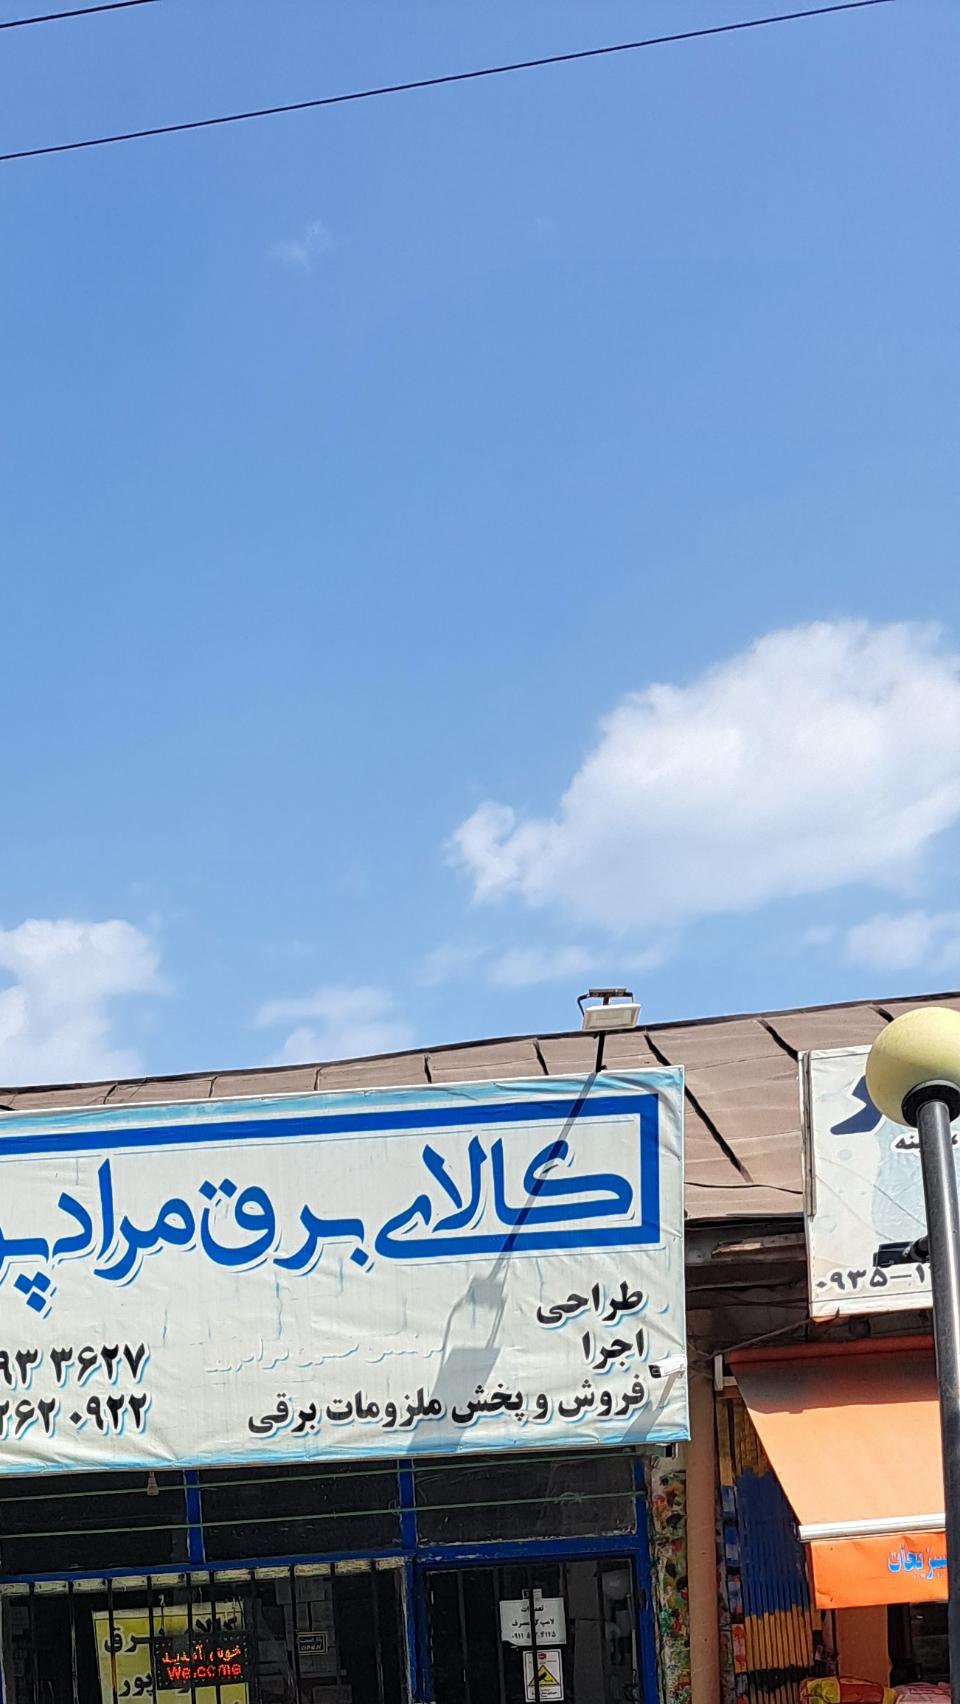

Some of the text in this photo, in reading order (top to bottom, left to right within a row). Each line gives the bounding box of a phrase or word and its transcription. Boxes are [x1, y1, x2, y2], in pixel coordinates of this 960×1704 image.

[375, 1135, 635, 1260] کالای
[200, 1177, 375, 1273] برق
[538, 1281, 643, 1325] طراحی
[49, 1342, 146, 1383] ۳۶۲۷
[583, 1328, 645, 1370] اجرا
[68, 1391, 147, 1432] ۰۹۲۲
[247, 1374, 648, 1434] فروش و پخش ملزومات برقی
